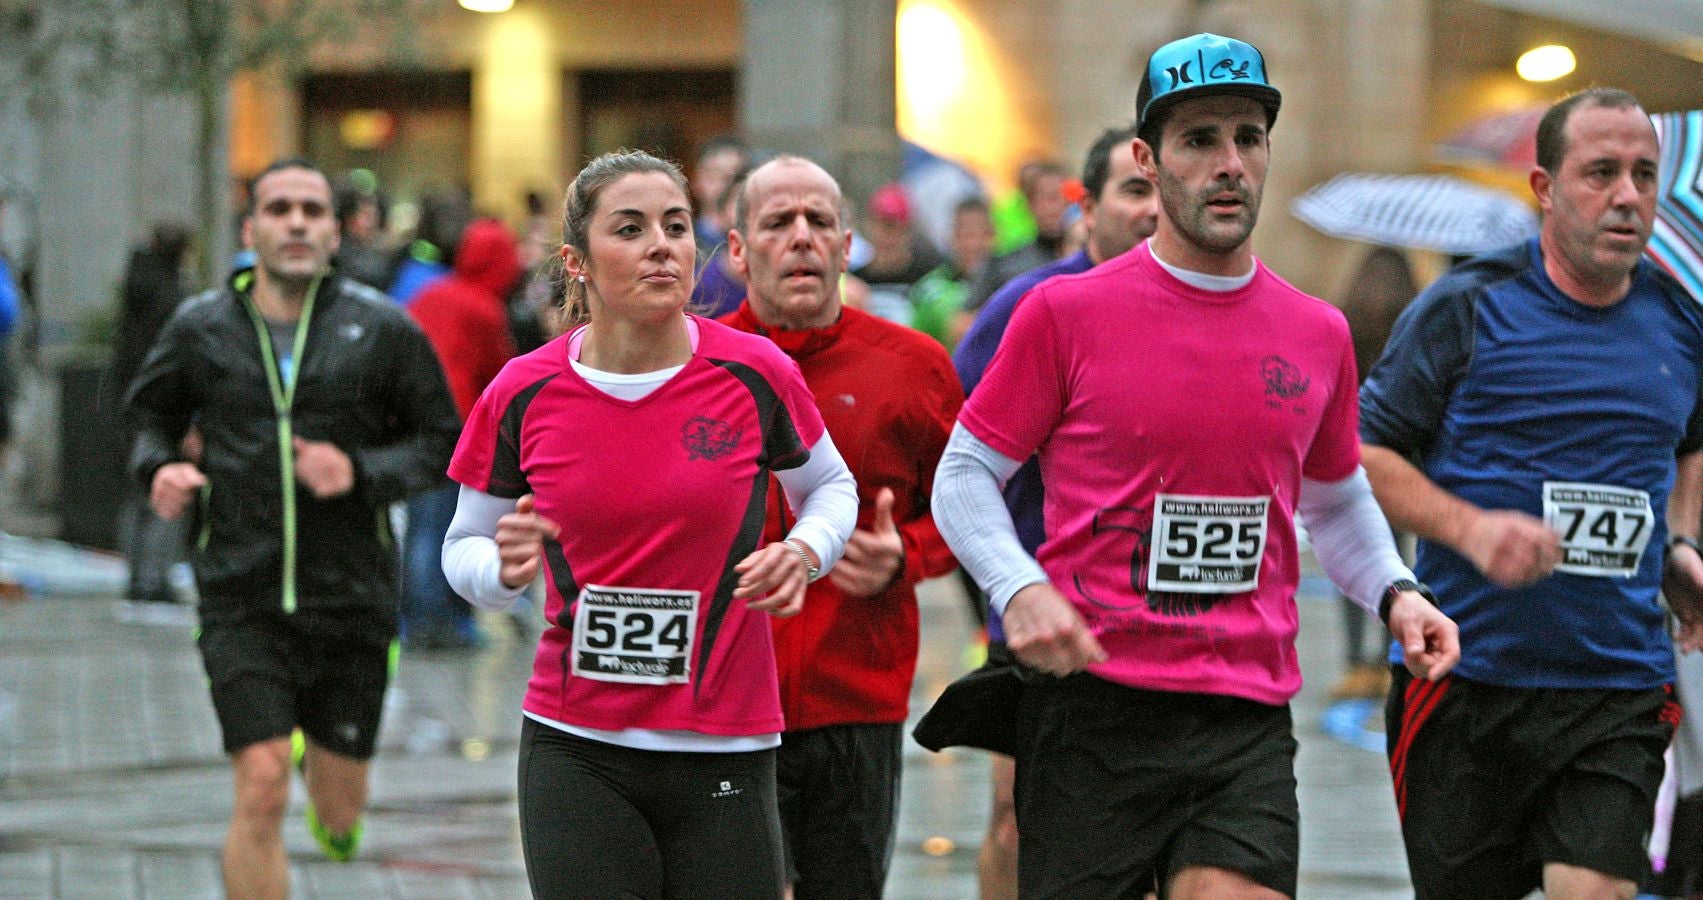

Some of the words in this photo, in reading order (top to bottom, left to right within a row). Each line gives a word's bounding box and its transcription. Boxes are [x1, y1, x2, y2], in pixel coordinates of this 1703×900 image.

[1166, 520, 1262, 559] 525
[1559, 508, 1646, 548] 747
[586, 609, 689, 653] 524
